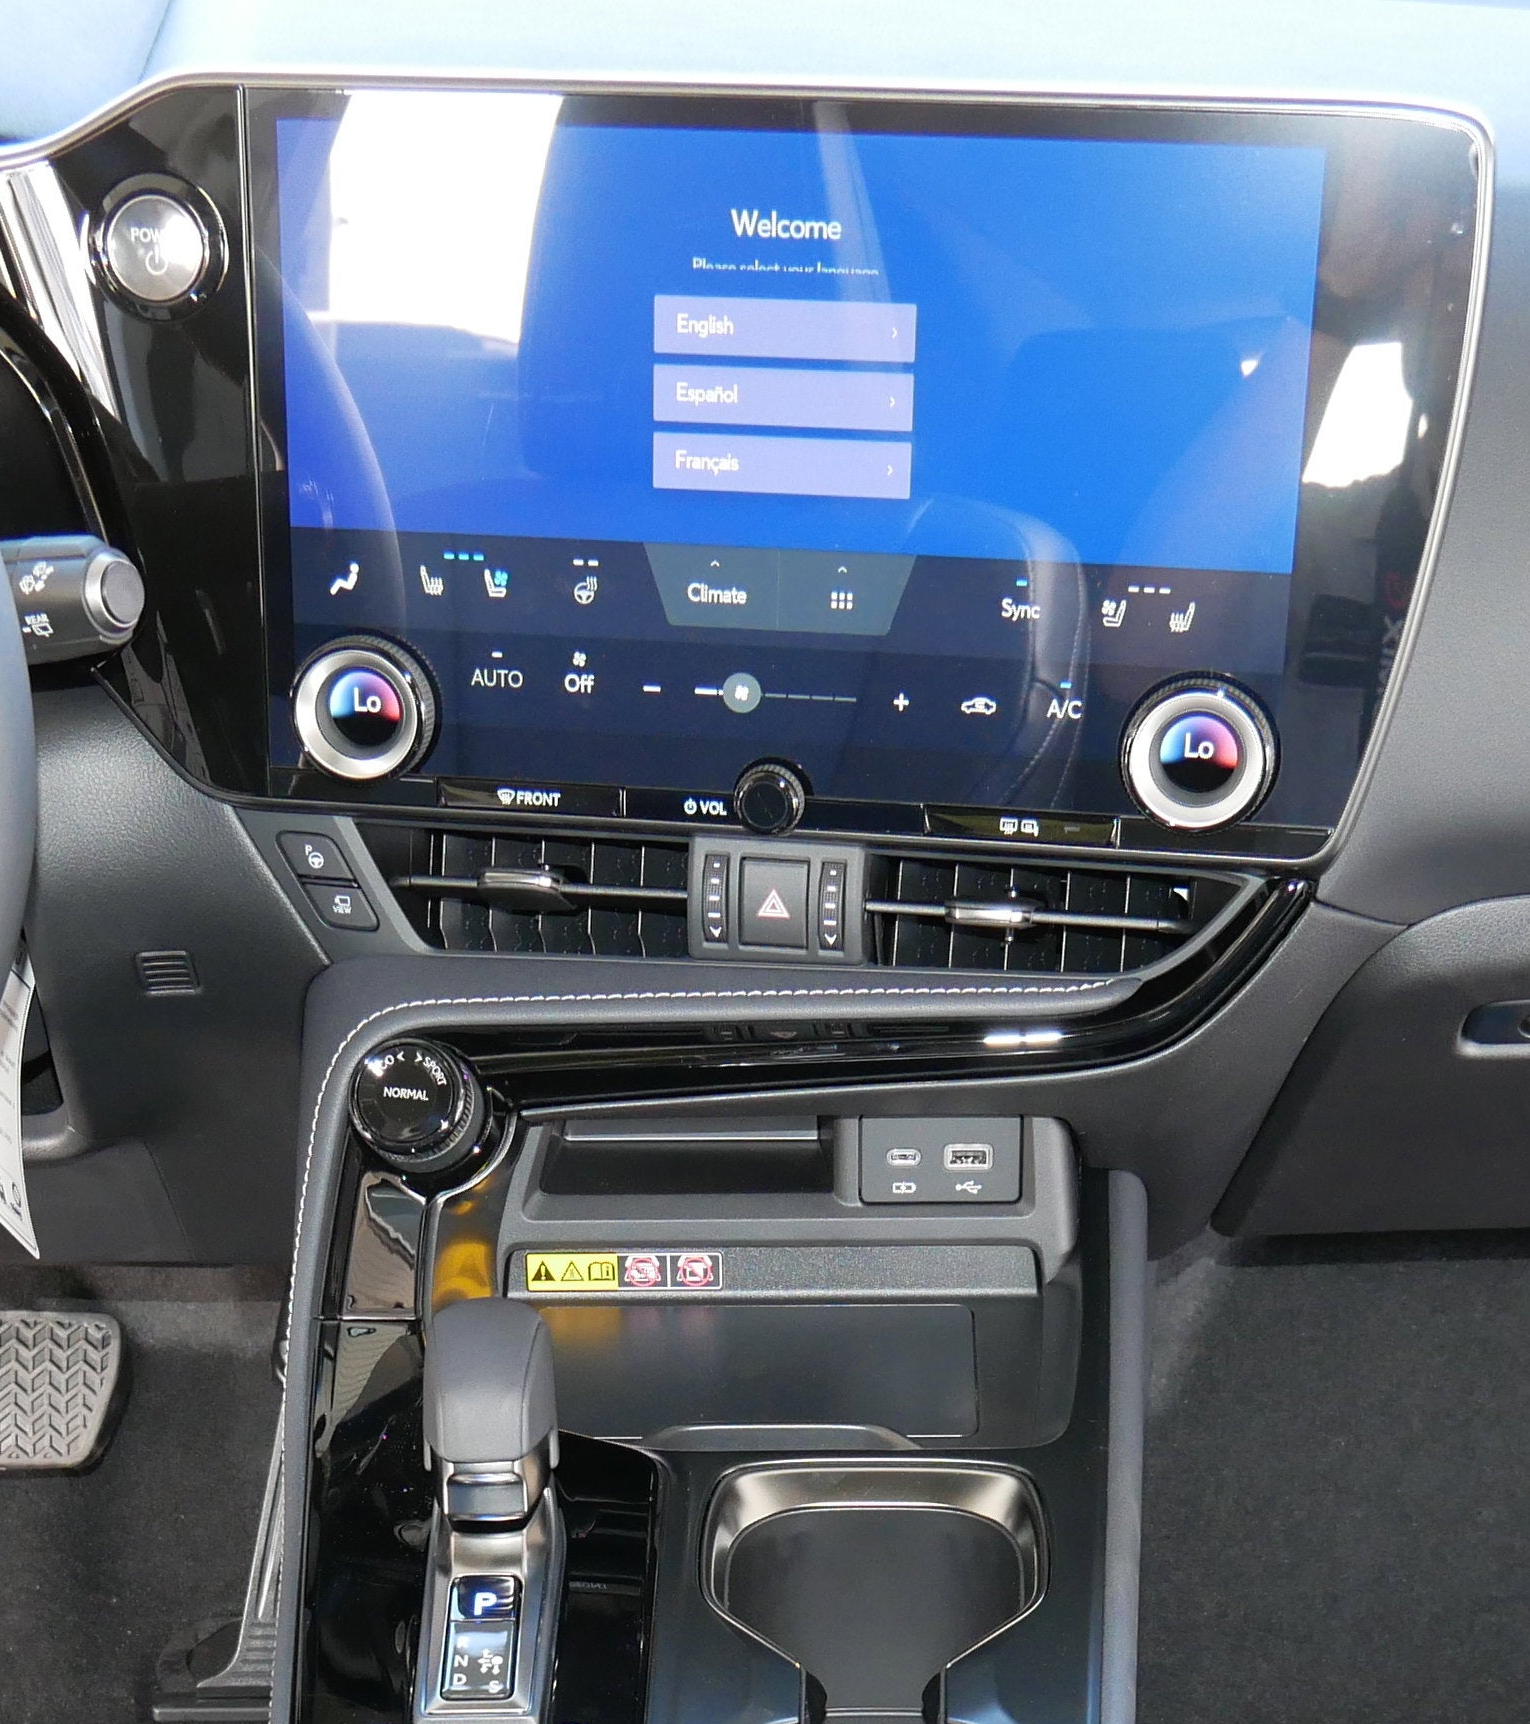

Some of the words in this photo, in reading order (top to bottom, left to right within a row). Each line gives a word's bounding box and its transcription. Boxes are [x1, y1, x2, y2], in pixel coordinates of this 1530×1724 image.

[730, 208, 842, 240] Welcome
[676, 313, 734, 338] English
[676, 382, 738, 406] Español
[675, 450, 739, 475] Français
[687, 582, 747, 605] Climate
[25, 613, 49, 625] REAR
[1001, 598, 1040, 620] Sync
[471, 669, 523, 689] AUTO
[564, 673, 594, 693] Off
[353, 688, 381, 714] Lo
[1047, 699, 1082, 720] A/C
[1184, 733, 1215, 760] Lo
[516, 790, 561, 807] FRONT
[700, 801, 727, 816] VOL
[332, 905, 352, 914] VIEW
[422, 1056, 447, 1087] SPORT
[383, 1086, 429, 1101] NORMAL
[474, 1591, 497, 1615] P
[454, 1654, 469, 1667] N
[452, 1673, 467, 1685] D
